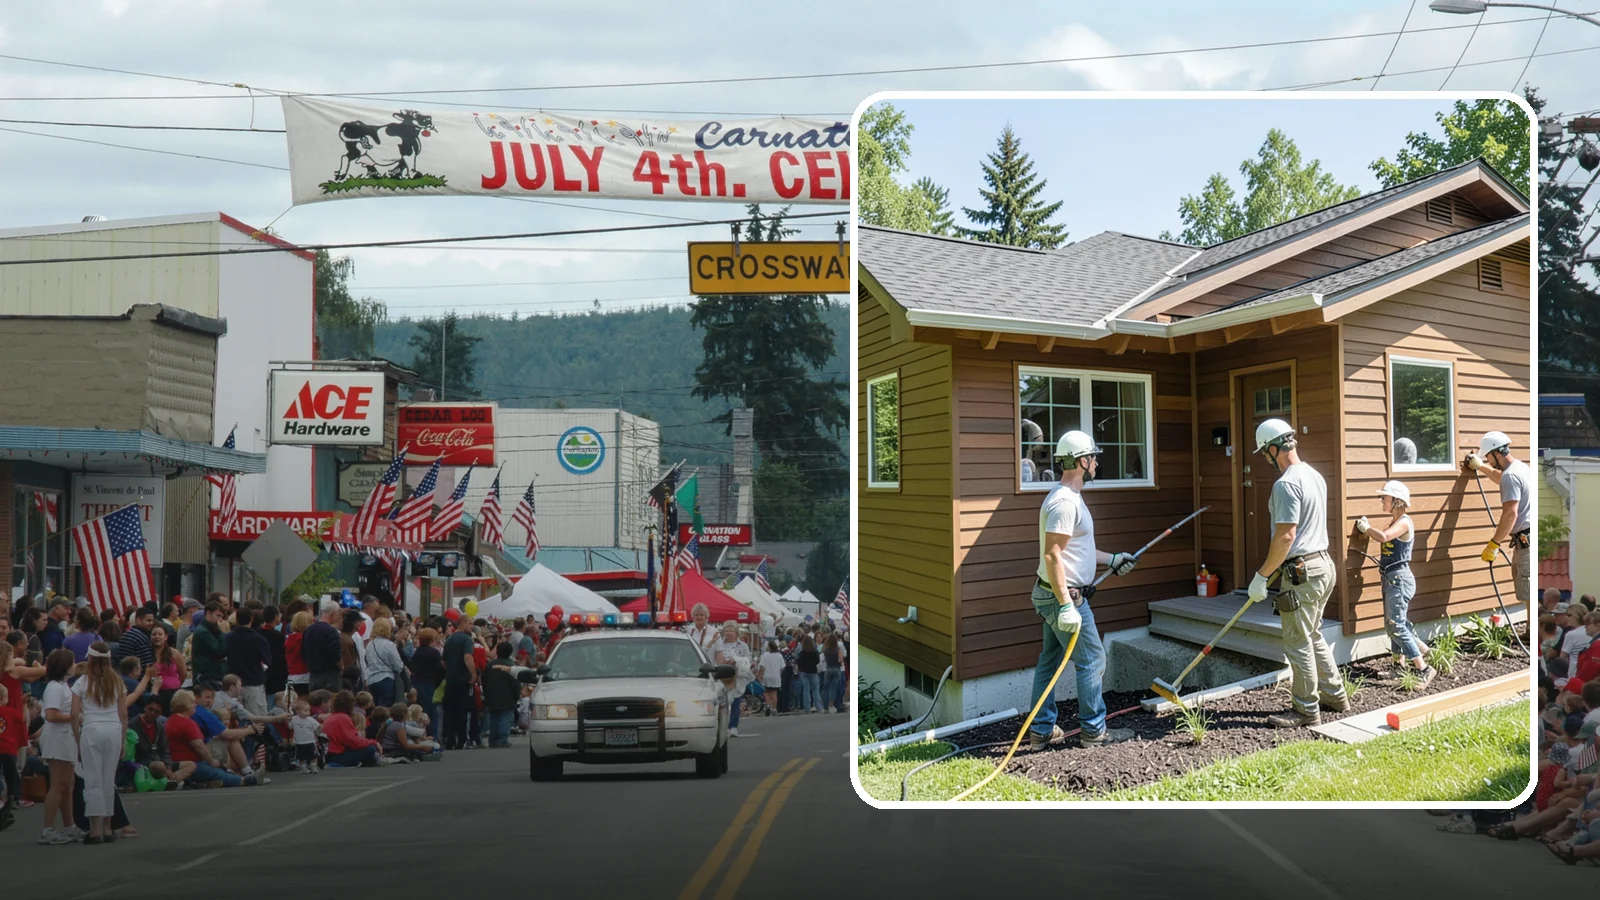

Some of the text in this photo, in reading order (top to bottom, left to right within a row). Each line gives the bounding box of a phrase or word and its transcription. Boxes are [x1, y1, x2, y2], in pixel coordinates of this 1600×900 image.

[481, 141, 605, 193] JULY
[632, 150, 746, 198] 4th.
[697, 255, 850, 280] CROSSWA
[283, 380, 373, 420] ACE
[405, 409, 452, 422] CEDAR
[283, 421, 371, 436] Hardware
[95, 485, 124, 495] Vincent
[126, 486, 135, 495] de
[137, 486, 155, 495] Paul
[212, 515, 331, 536] HARDARE
[688, 526, 742, 535] CRNATION
[699, 535, 730, 543] GLASS
